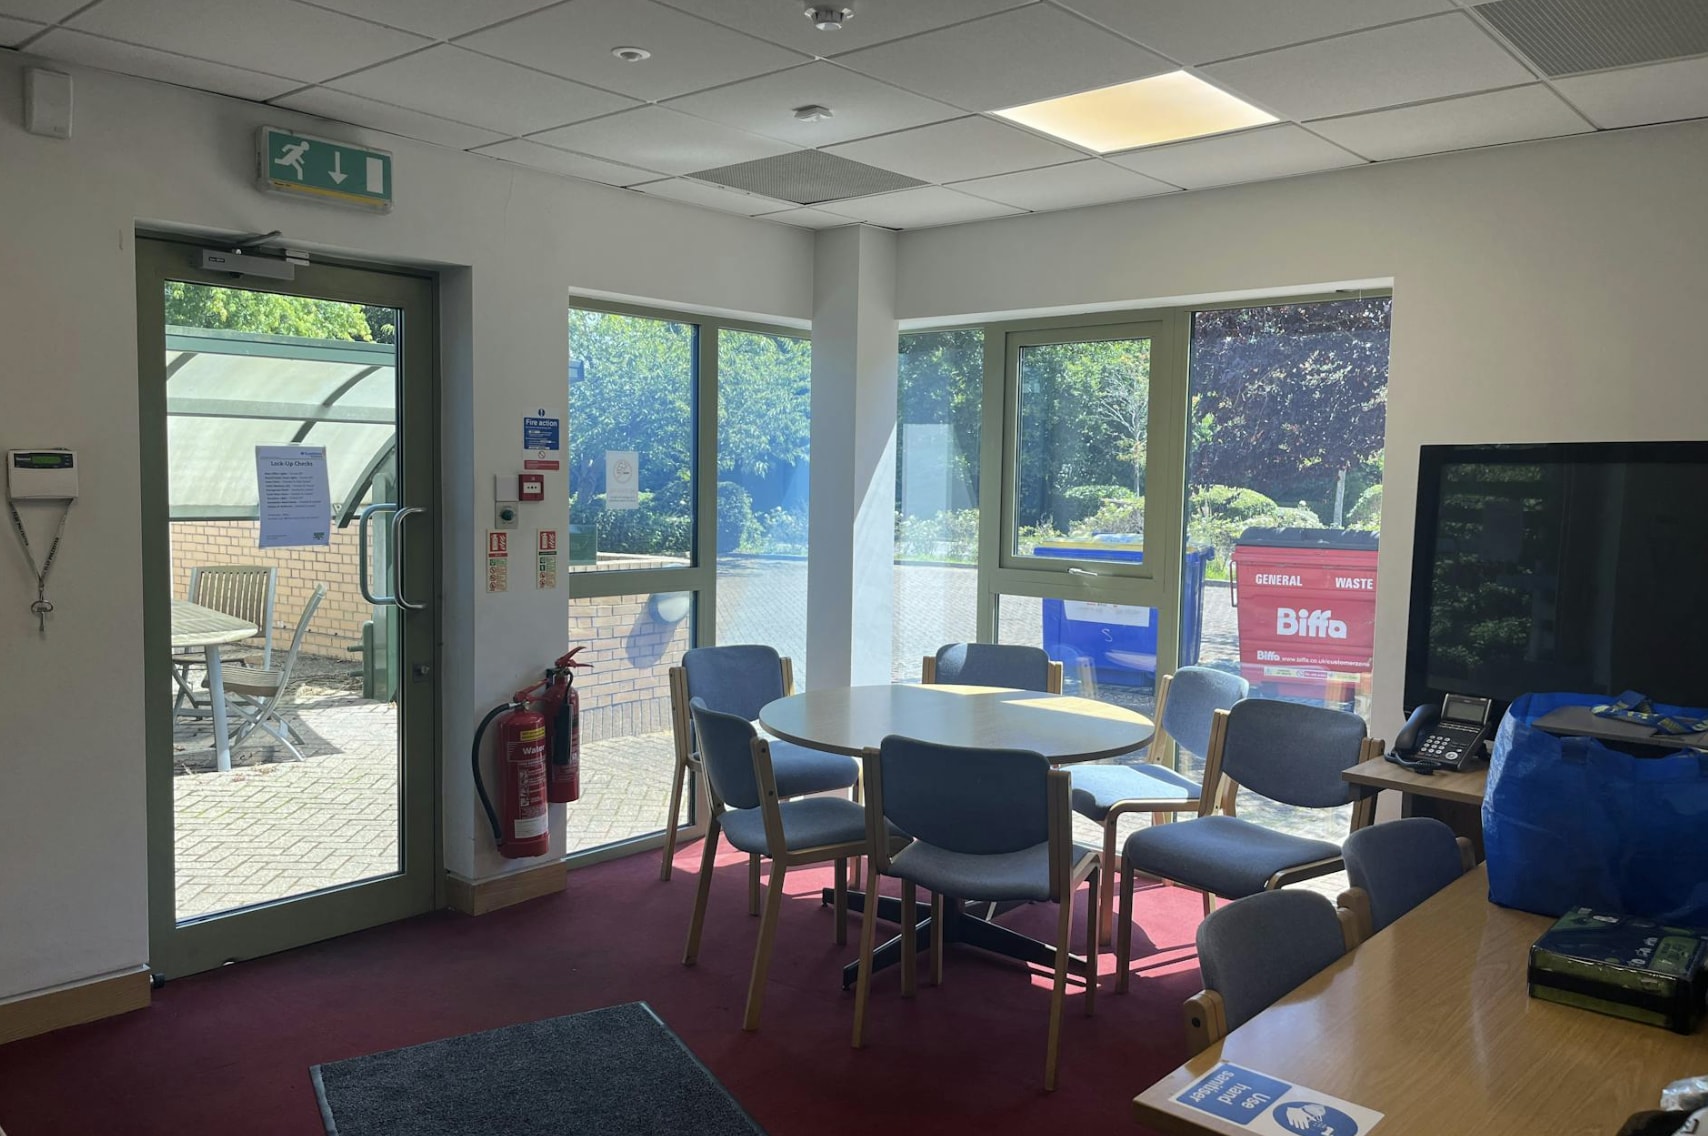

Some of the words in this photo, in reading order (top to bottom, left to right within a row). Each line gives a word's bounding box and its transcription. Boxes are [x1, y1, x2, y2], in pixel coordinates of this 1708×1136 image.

[525, 418, 538, 426] Fire
[1255, 573, 1303, 586] GENERAL
[1335, 577, 1374, 589] WASTE
[1276, 607, 1347, 639] Biffa
[1256, 650, 1281, 661] Biffa
[1189, 1070, 1235, 1103] sanitiser
[1218, 1083, 1252, 1105] hand
[1241, 1092, 1271, 1109] Use
